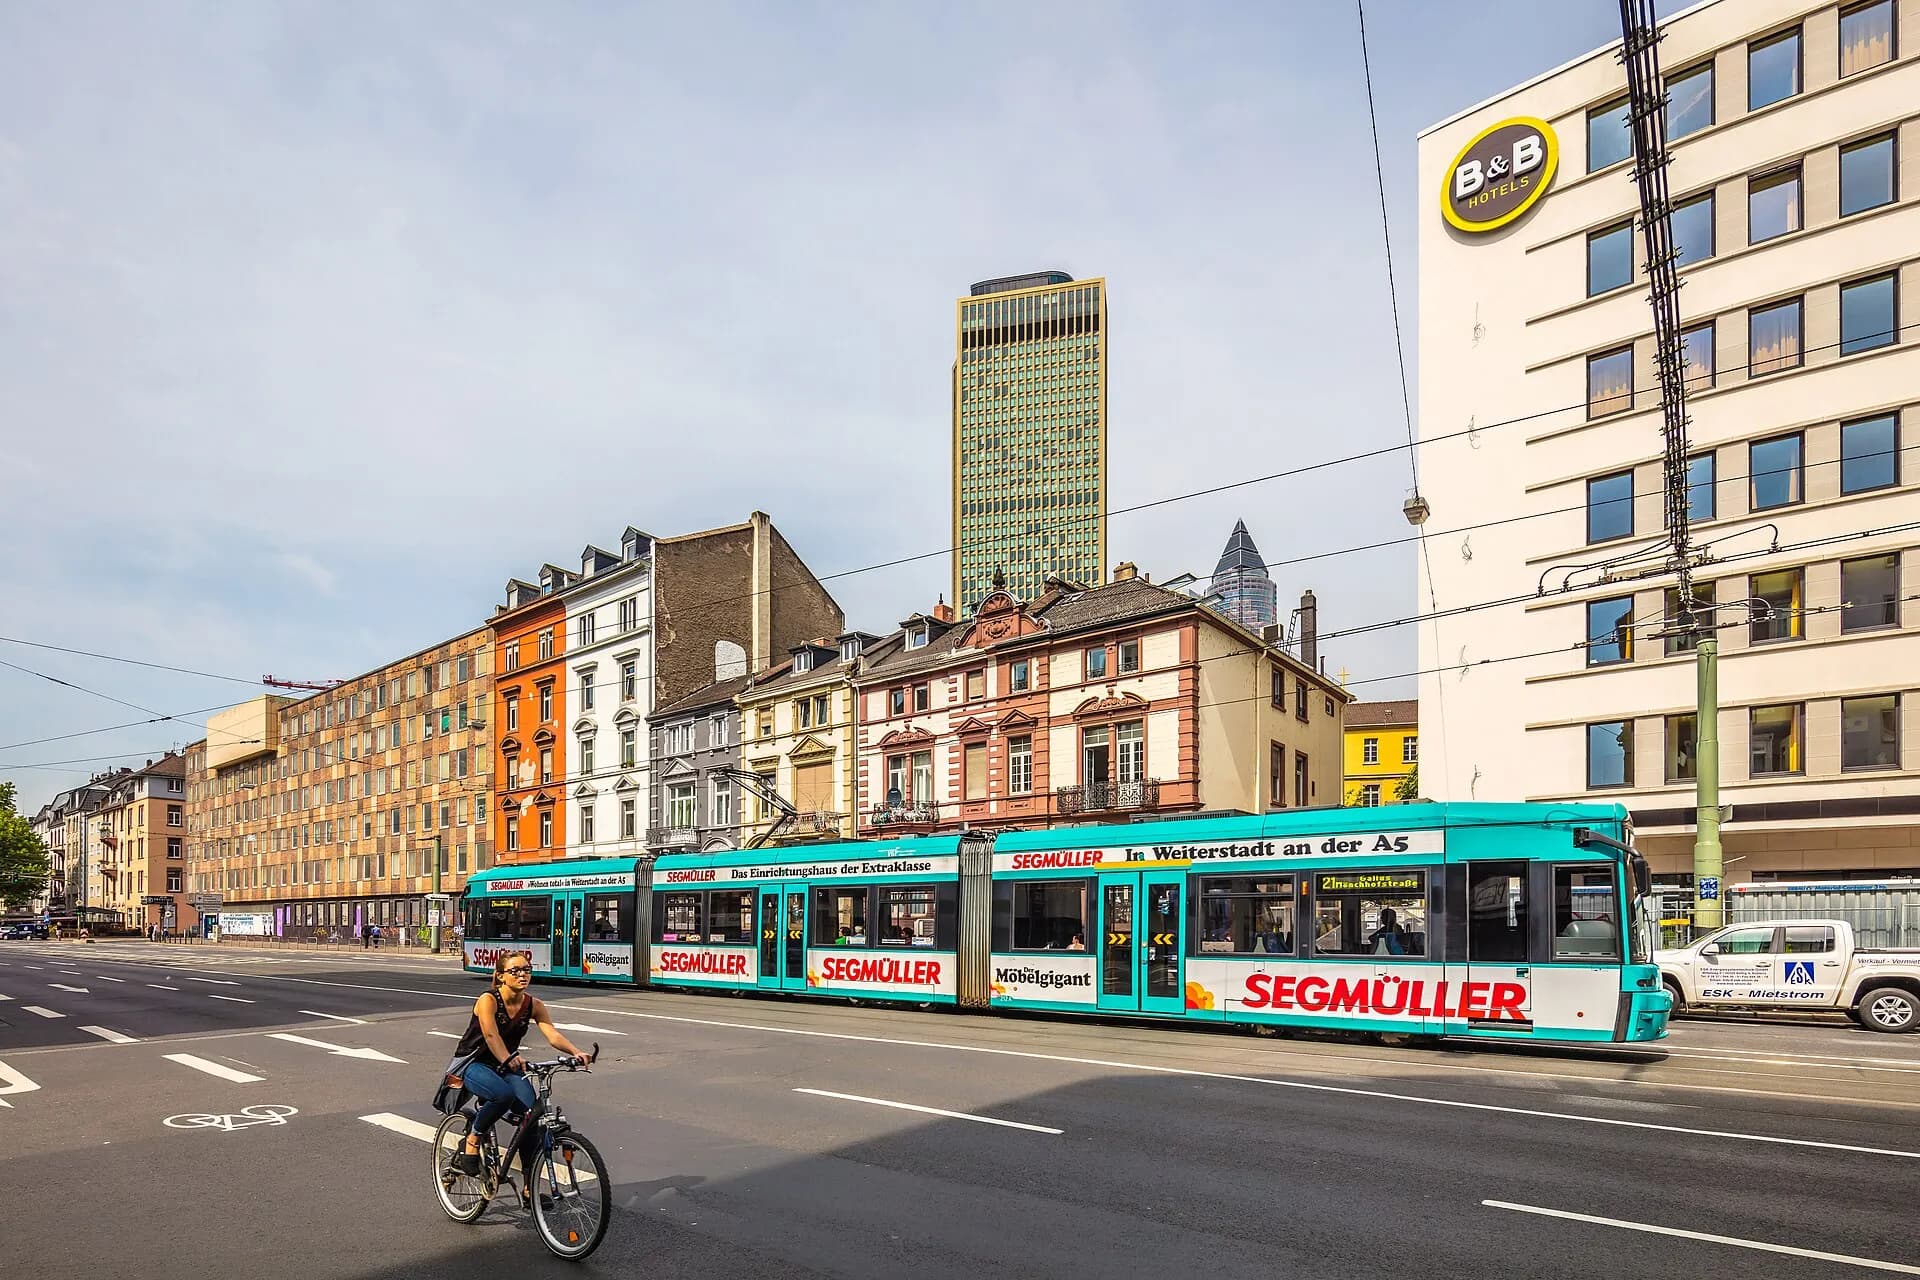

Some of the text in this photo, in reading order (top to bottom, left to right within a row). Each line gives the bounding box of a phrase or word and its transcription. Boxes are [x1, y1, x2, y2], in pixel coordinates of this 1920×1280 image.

[1455, 134, 1543, 199] B&B
[1468, 176, 1530, 209] HOTELS
[1152, 841, 1275, 861] Weiterstadt
[1283, 842, 1311, 855] an
[1321, 838, 1362, 854] der
[1372, 834, 1409, 852] A5
[1012, 850, 1103, 869] SEGMÜLLER
[666, 869, 715, 882] SEGMÜLLER
[731, 861, 931, 880] Das Einrichtungshaus der Extraklasse
[491, 880, 523, 890] SEGMÜLLER
[571, 877, 600, 886] Weiterstadt
[608, 876, 617, 885] der
[618, 876, 626, 884] A5
[1322, 877, 1335, 889] 21
[473, 948, 532, 966] SEGMR
[660, 952, 746, 975] SEGMÜLLER
[822, 957, 940, 985] SEGMÜLLER
[995, 967, 1091, 989] Möbelgigant
[1241, 973, 1529, 1020] SEGMÜLLER
[1702, 989, 1734, 998] ESK
[1748, 990, 1825, 999] Mietstrom
